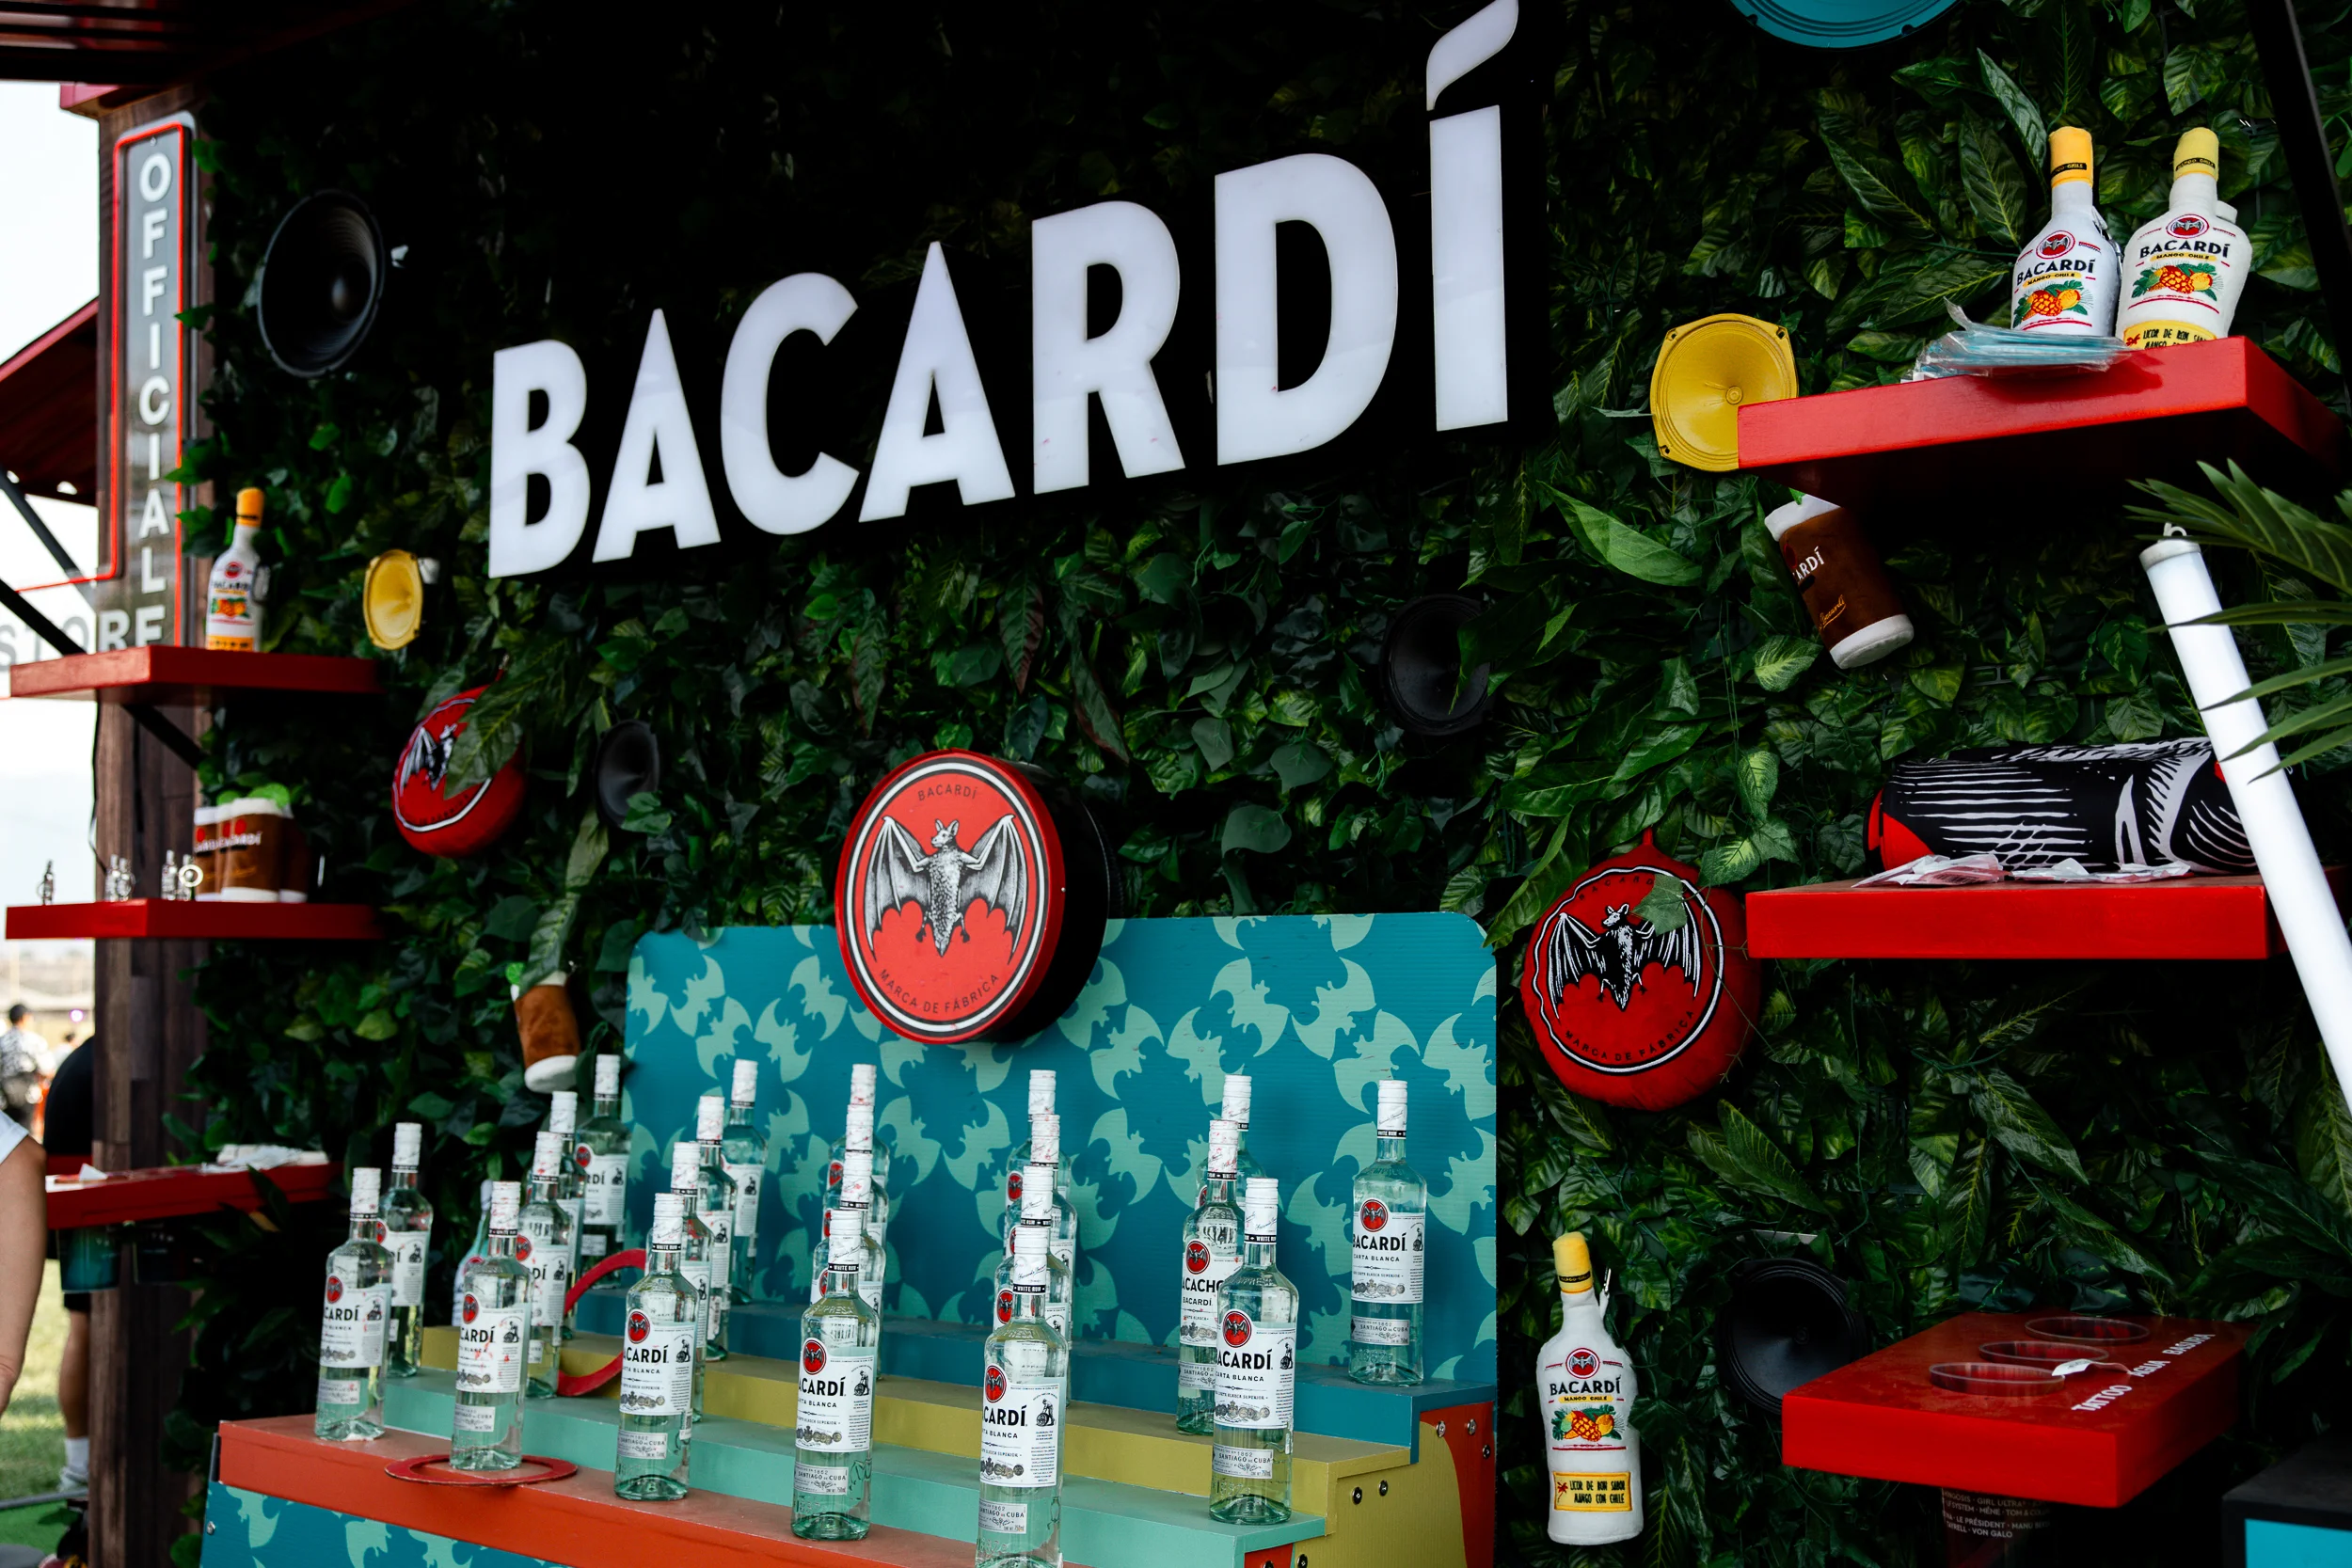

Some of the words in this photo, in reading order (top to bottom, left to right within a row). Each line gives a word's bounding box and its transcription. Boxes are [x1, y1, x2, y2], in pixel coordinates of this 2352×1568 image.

[2139, 239, 2231, 259] BACARDÍ
[2017, 259, 2096, 286] BACARDÍ
[2027, 275, 2051, 285] MANGO
[488, 0, 1518, 579] BACARDÍ
[2143, 329, 2160, 340] LICOR
[2164, 329, 2173, 339] DE
[137, 152, 173, 594] OFFICIAL
[917, 784, 978, 801] BACARDÍ
[1579, 875, 1654, 900] BACARD
[879, 968, 918, 1009] MARCA
[924, 1001, 939, 1015] DE
[945, 974, 999, 1014] FÁBRICA
[1565, 1030, 1608, 1060] MARCA
[1615, 1052, 1633, 1062] DE
[1639, 1009, 1694, 1058] FÁBRICA
[1360, 1323, 1387, 1332] SANTIAGO
[2161, 1334, 2217, 1355] BASURA
[623, 1344, 669, 1364] CARDÍ
[1216, 1348, 1273, 1370] ACARDÍ
[1184, 1369, 1209, 1377] SANTIAGO
[1549, 1375, 1622, 1396] BACARDÍ
[2071, 1385, 2133, 1411] TATTOO
[982, 1404, 1028, 1427] CARDÍ
[990, 1430, 1018, 1439] BLANCA
[1218, 1453, 1248, 1463] SANTIAGO
[798, 1470, 823, 1481] SANTIAGO
[1569, 1481, 1583, 1491] LICOR
[1586, 1481, 1594, 1491] DE
[1611, 1481, 1626, 1491] SABOR
[1574, 1493, 1592, 1503] MANGO
[1596, 1493, 1607, 1503] CON
[1610, 1493, 1625, 1503] CHILE
[1977, 1497, 1995, 1506] GIRL
[1951, 1501, 1975, 1513] SYSTEM
[2005, 1509, 2023, 1517] TOM
[1956, 1515, 1963, 1524] LE
[1964, 1518, 2006, 1529] PRÉSIDENT
[1972, 1528, 1989, 1537] VON
[1990, 1529, 2013, 1539] GALO
